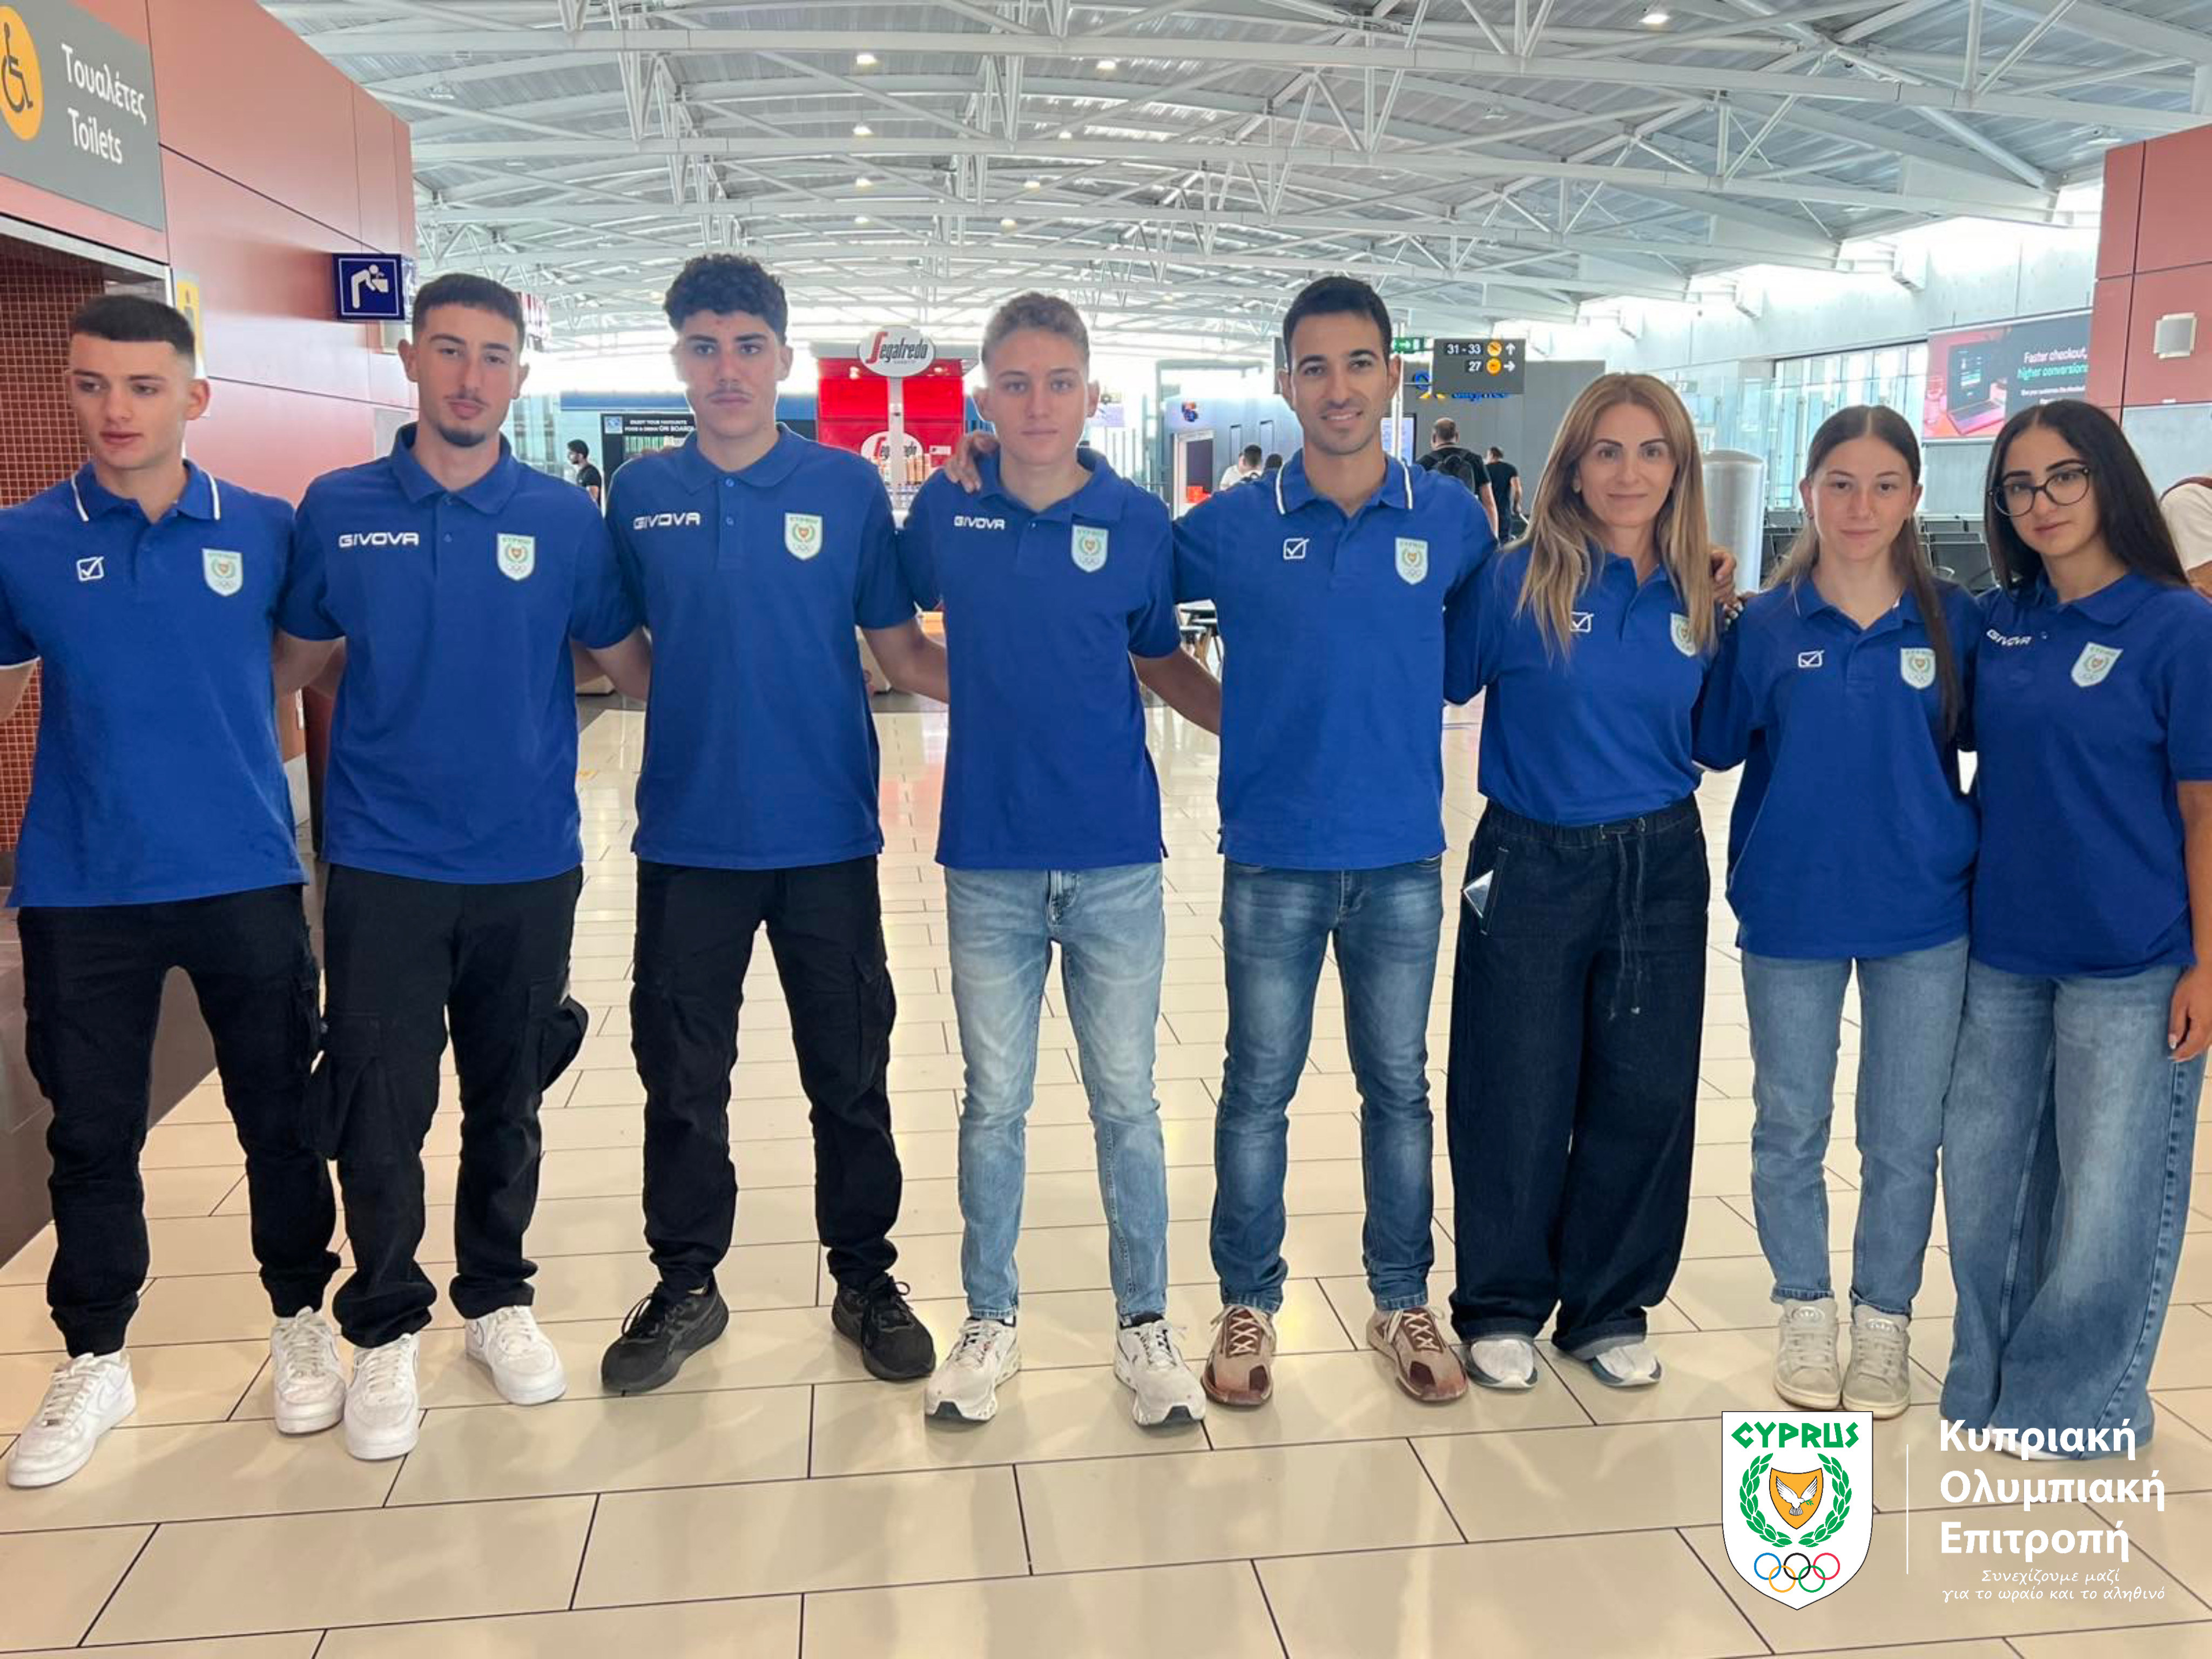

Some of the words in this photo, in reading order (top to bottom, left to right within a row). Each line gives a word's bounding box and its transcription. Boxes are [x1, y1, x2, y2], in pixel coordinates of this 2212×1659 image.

[62, 43, 146, 125] Τουαλέτες
[68, 107, 123, 164] Toilets
[865, 331, 928, 363] Segafredo
[1447, 343, 1459, 355] 31
[1467, 343, 1481, 355] 33
[1468, 361, 1482, 372] 27
[632, 512, 700, 530] GIVOVA
[954, 515, 1006, 530] GIVOVA
[338, 532, 420, 548] GIVOVA
